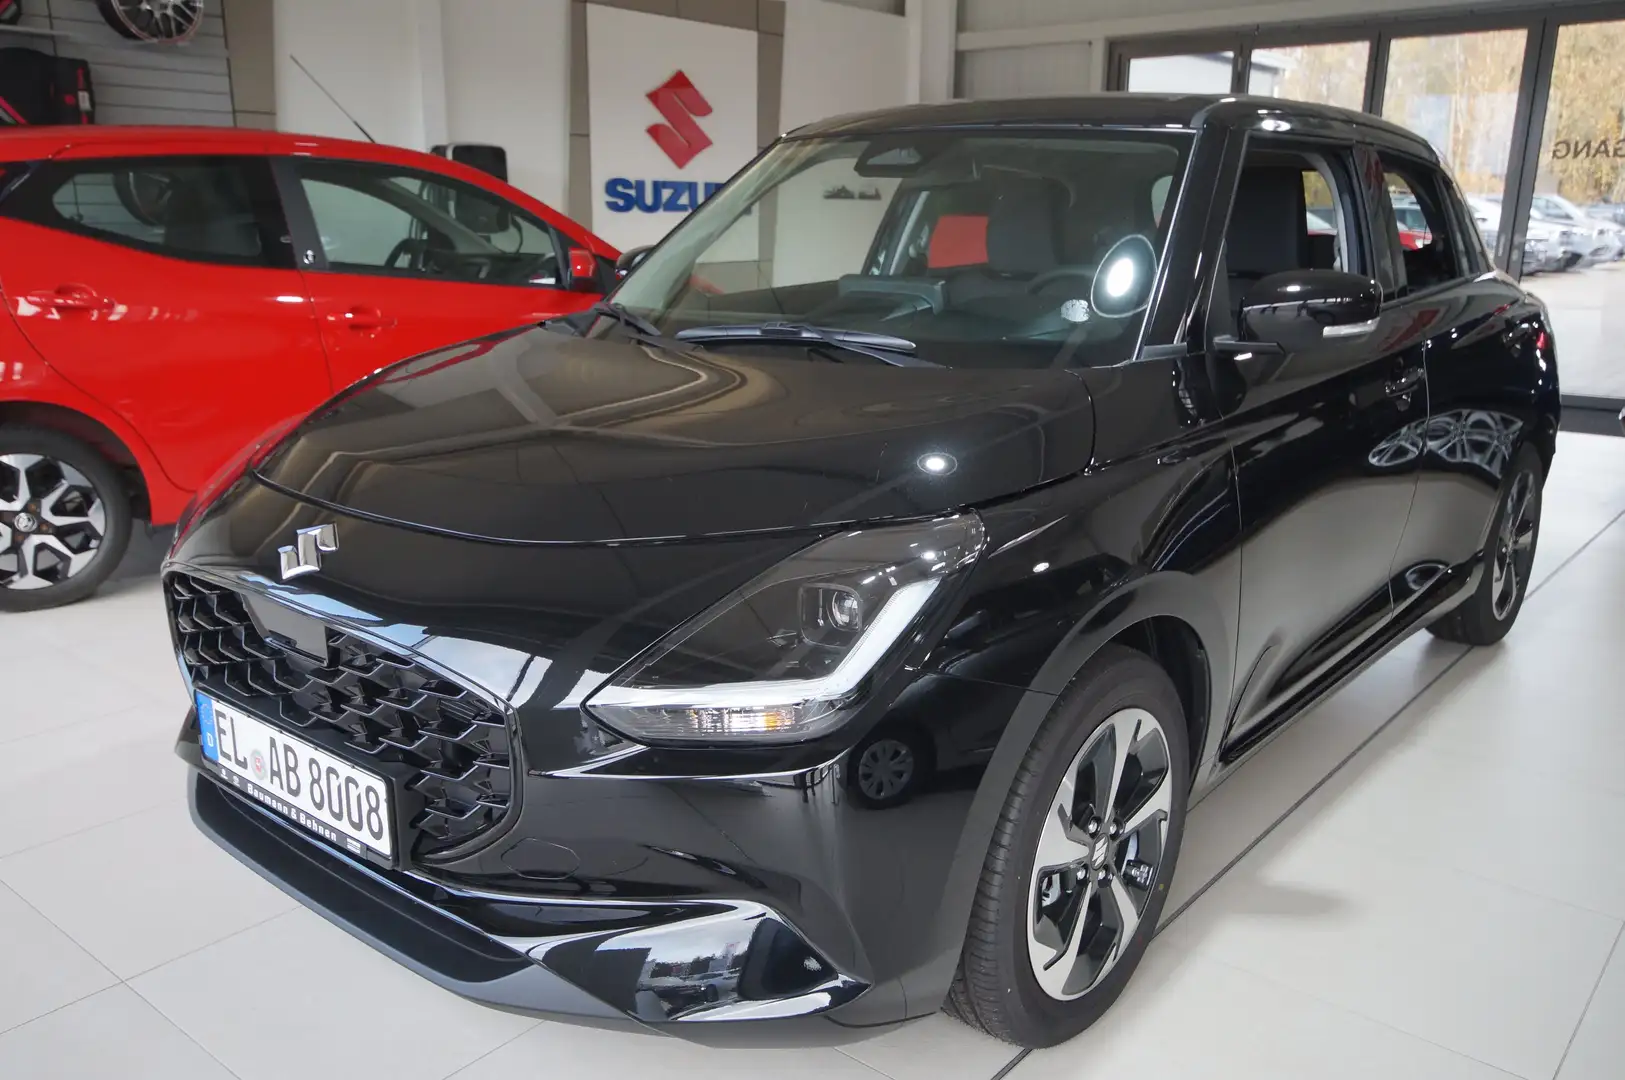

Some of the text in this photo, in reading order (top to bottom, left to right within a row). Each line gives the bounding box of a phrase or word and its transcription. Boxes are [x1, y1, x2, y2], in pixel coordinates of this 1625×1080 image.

[605, 177, 726, 213] SUZU
[207, 731, 214, 748] D
[215, 708, 384, 841] EL AB 8008
[247, 782, 337, 842] Baumann & Behnen
